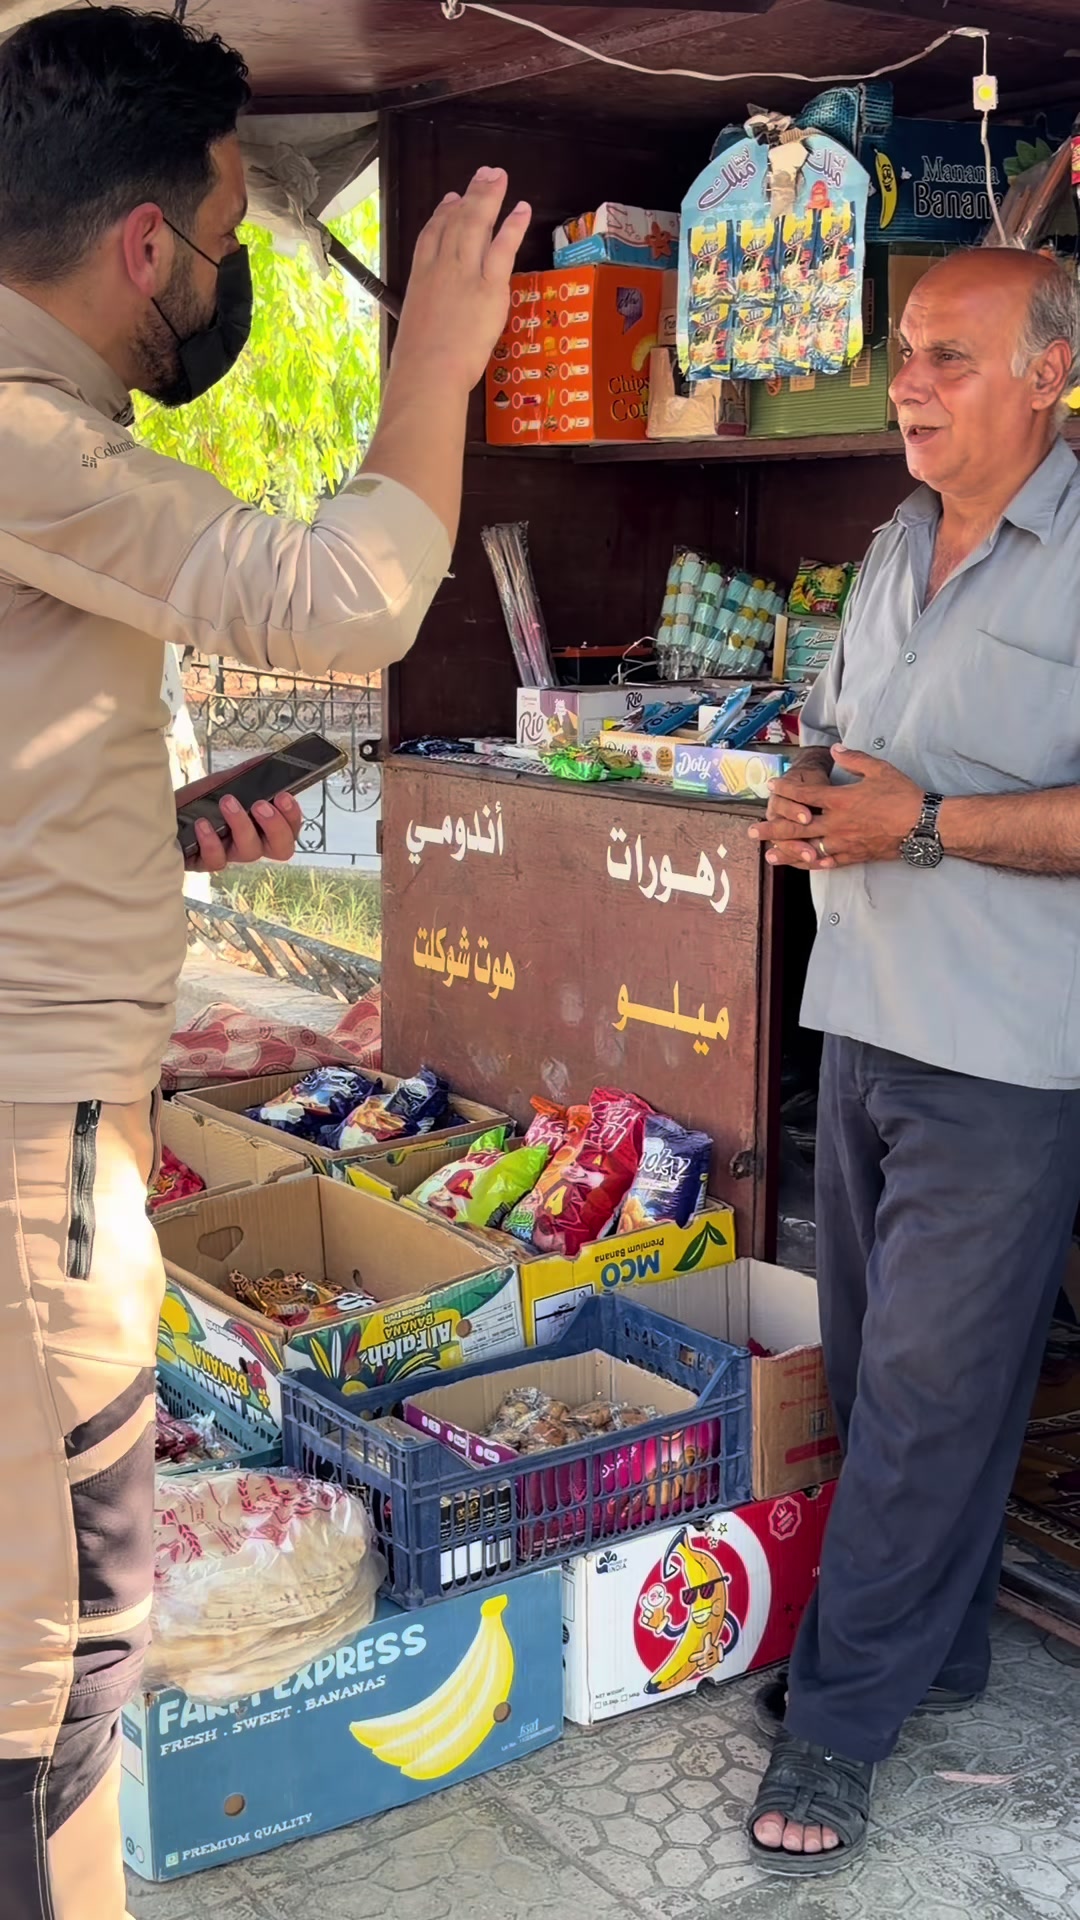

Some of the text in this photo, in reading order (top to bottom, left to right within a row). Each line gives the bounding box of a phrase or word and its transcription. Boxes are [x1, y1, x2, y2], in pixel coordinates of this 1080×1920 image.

[921, 155, 1000, 185] Manana
[611, 399, 648, 421] Cor
[94, 440, 136, 459] Columb
[625, 691, 643, 711] Rio
[519, 711, 543, 743] Rio
[406, 801, 504, 864] أندومي
[606, 827, 730, 913] زهورات
[474, 936, 515, 999] هوت
[612, 981, 729, 1056] ميلو
[594, 1237, 664, 1263] Premium Banana
[601, 1249, 661, 1288] MCO
[383, 1312, 435, 1339] BANANA
[366, 1328, 427, 1368] Falah
[192, 1344, 251, 1398] BANANA
[273, 1623, 427, 1701] EXPRESS
[160, 1675, 386, 1756] FRESH SWEET BANANAS
[182, 1812, 313, 1861] PREMIUM QUALITY
